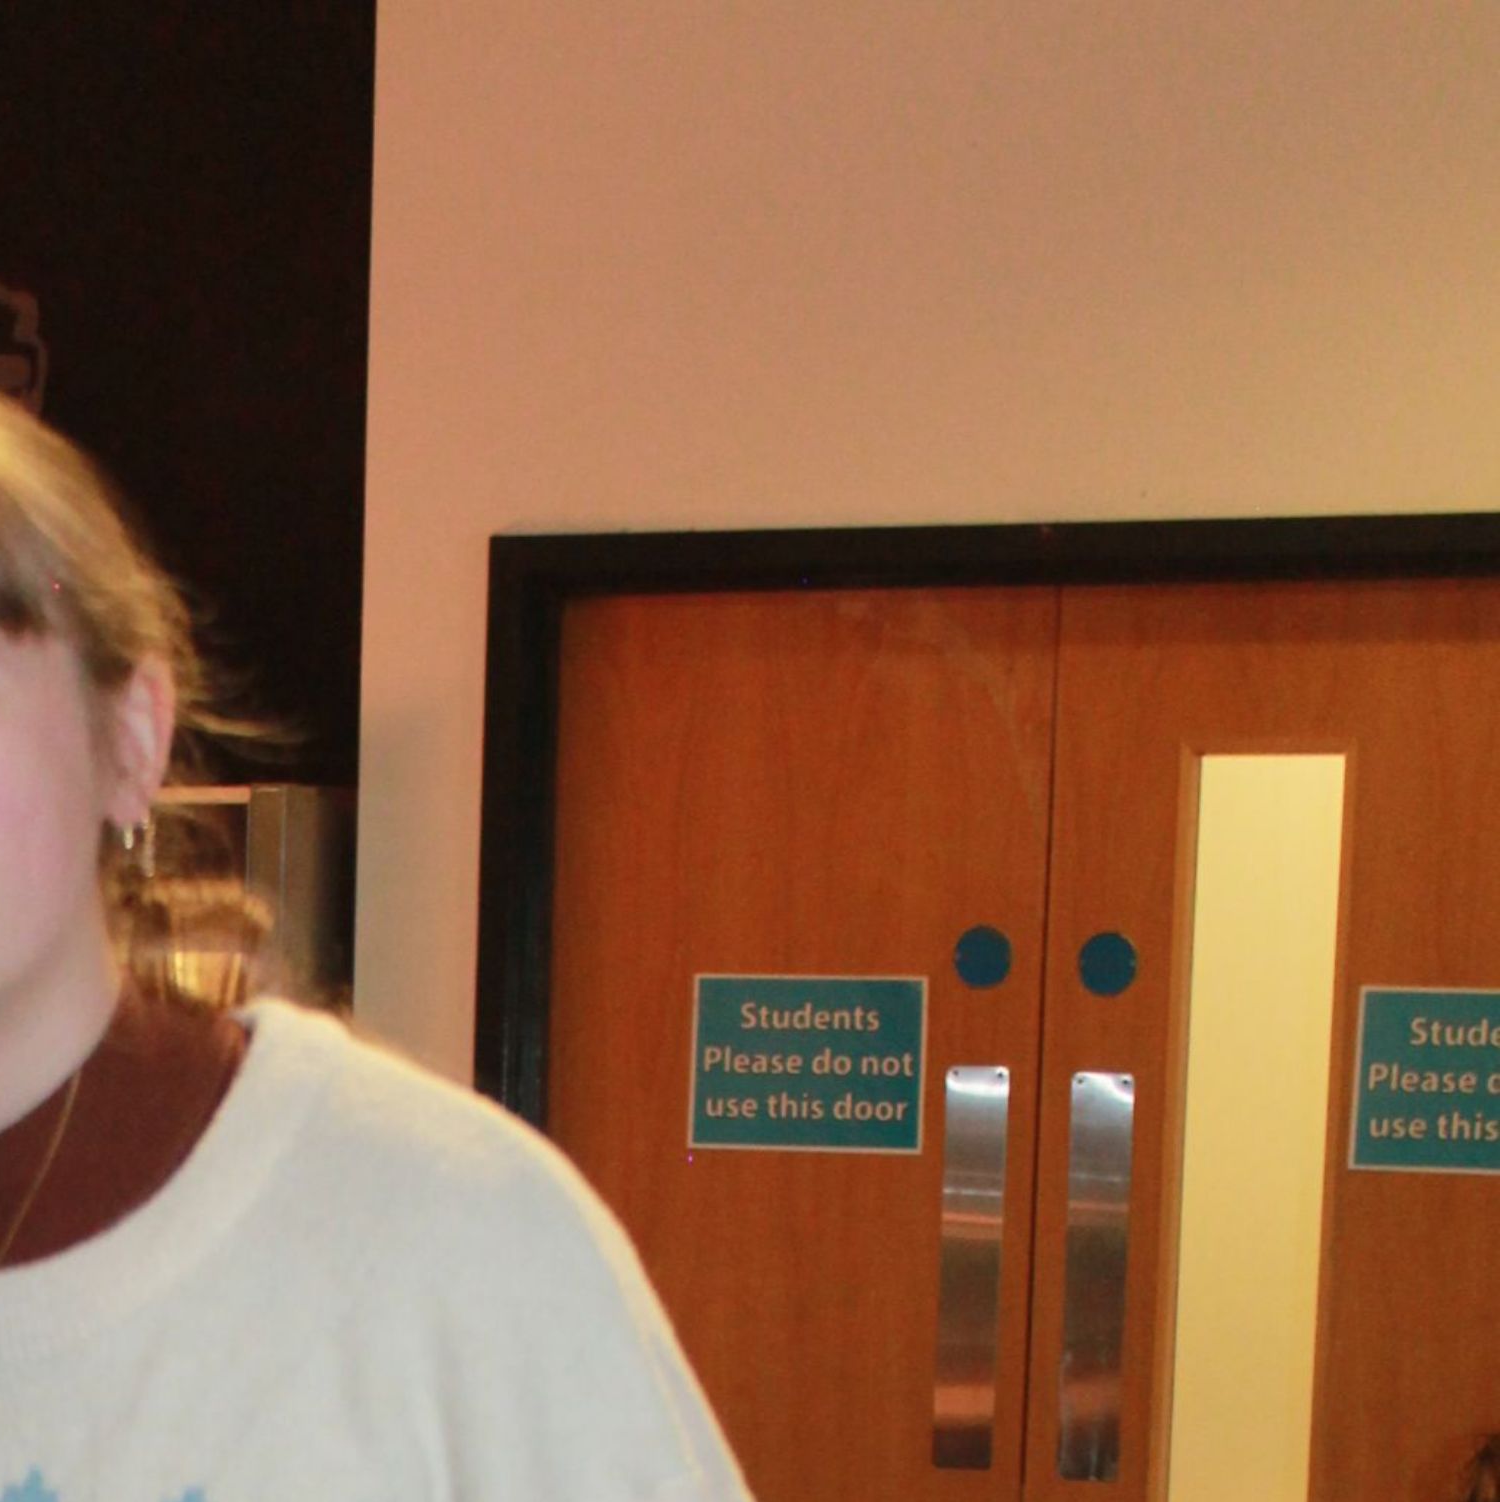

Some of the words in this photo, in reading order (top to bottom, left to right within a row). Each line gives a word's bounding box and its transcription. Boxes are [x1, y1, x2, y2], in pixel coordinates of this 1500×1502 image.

[740, 1002, 881, 1032] Students
[703, 1046, 804, 1075] Please
[811, 1047, 852, 1076] do
[860, 1052, 914, 1078] not
[1368, 1063, 1478, 1094] Please
[705, 1097, 759, 1119] use
[767, 1092, 825, 1120] this
[832, 1092, 908, 1122] door
[1369, 1116, 1428, 1140] use
[1437, 1111, 1500, 1142] this
